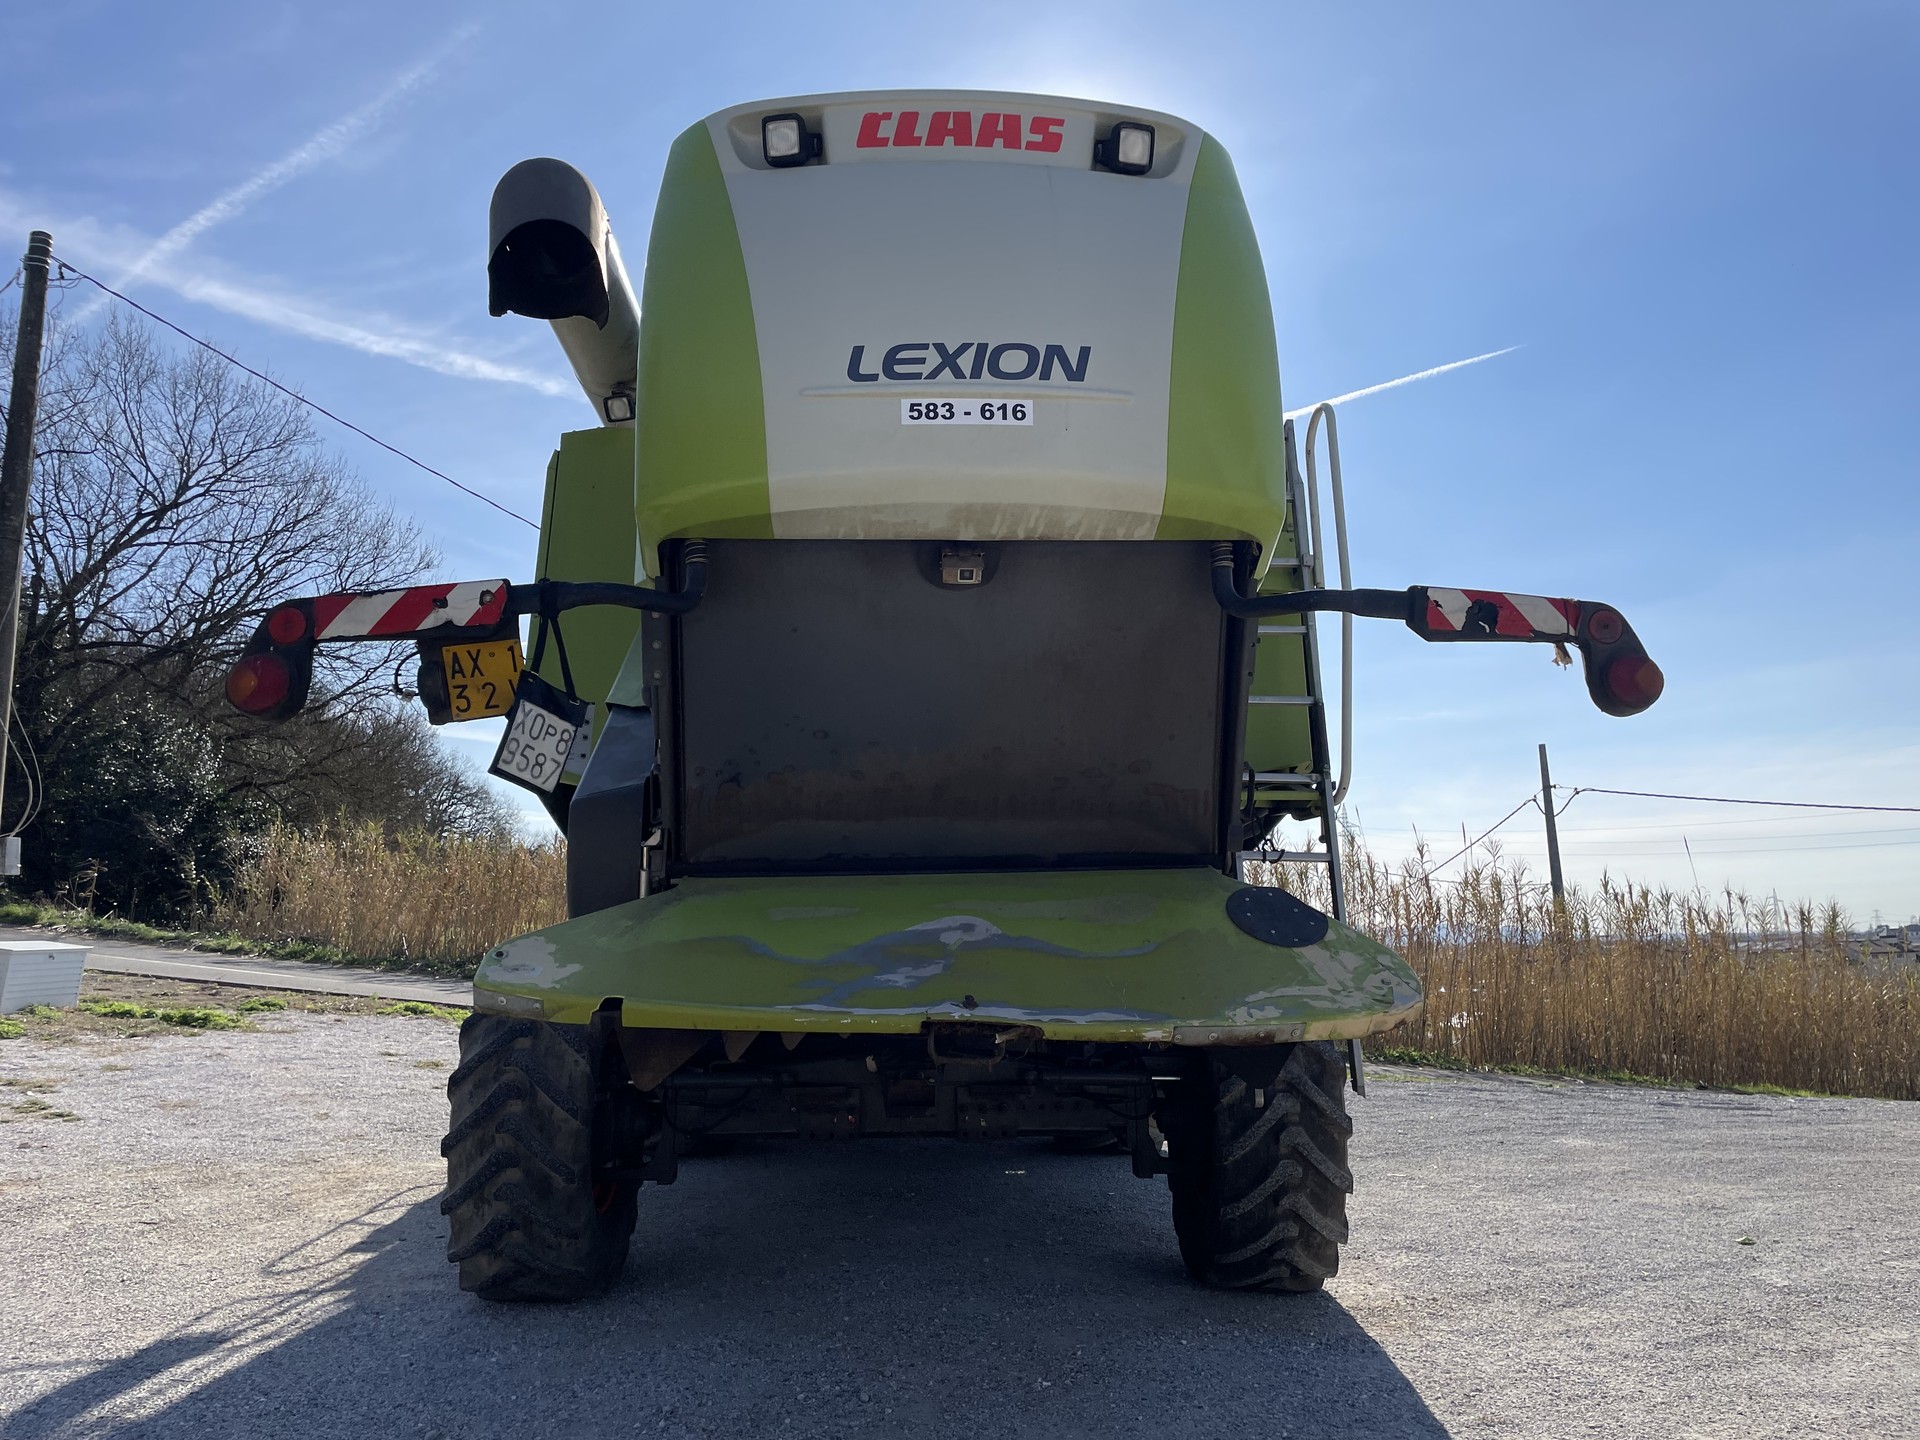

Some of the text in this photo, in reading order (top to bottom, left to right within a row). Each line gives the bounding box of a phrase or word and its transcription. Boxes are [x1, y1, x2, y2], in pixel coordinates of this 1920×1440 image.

[856, 111, 1065, 153] CLAAS
[847, 342, 1092, 383] LEXION
[907, 402, 955, 421] 583
[979, 403, 1027, 421] 616
[451, 648, 485, 679] AX
[501, 737, 562, 785] 9587
